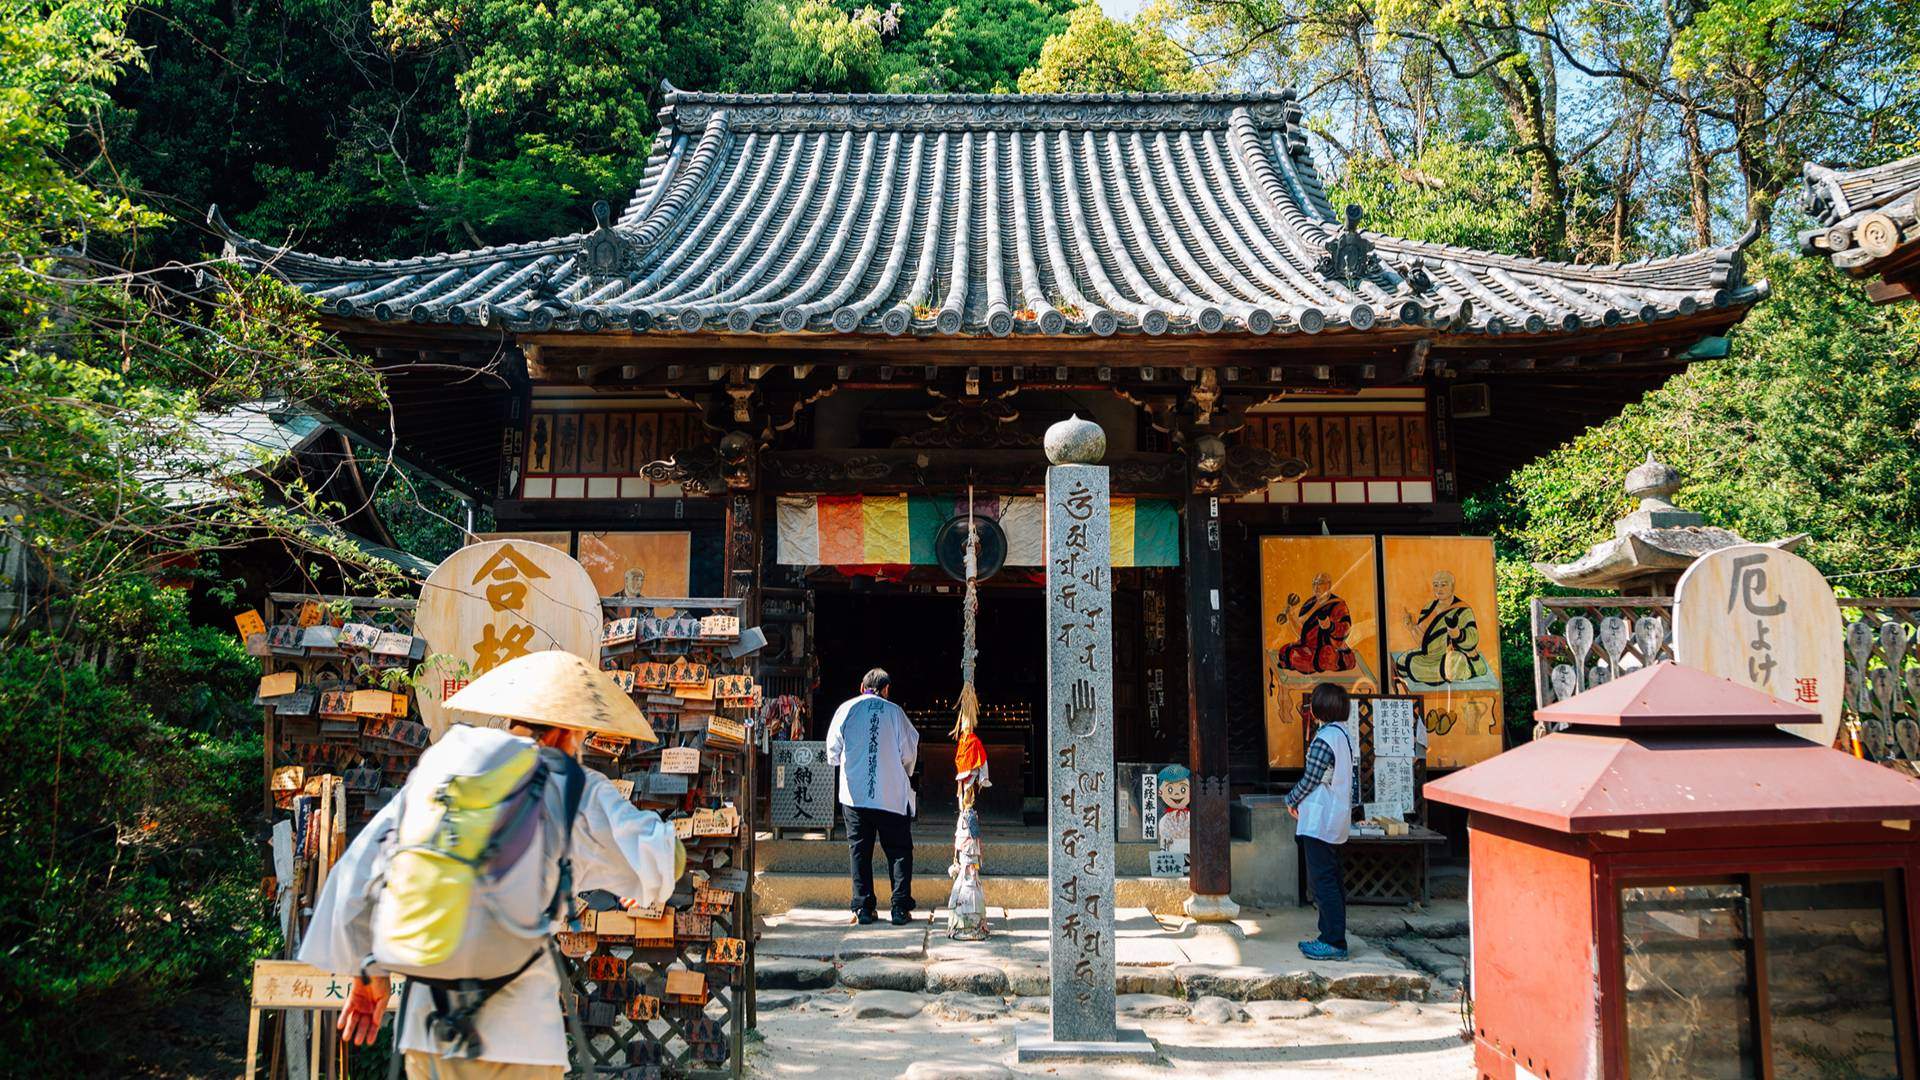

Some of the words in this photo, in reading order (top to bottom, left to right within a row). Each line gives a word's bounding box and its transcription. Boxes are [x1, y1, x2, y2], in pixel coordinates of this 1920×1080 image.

[1727, 553, 1787, 687] 厄よけ
[1794, 677, 1819, 704] 運
[1380, 701, 1390, 744] 恵まれます
[1400, 701, 1410, 744] 石を頂いて
[793, 766, 814, 819] 納札入
[1144, 776, 1156, 838] 写経奉納箱
[265, 977, 313, 1000] 奉納
